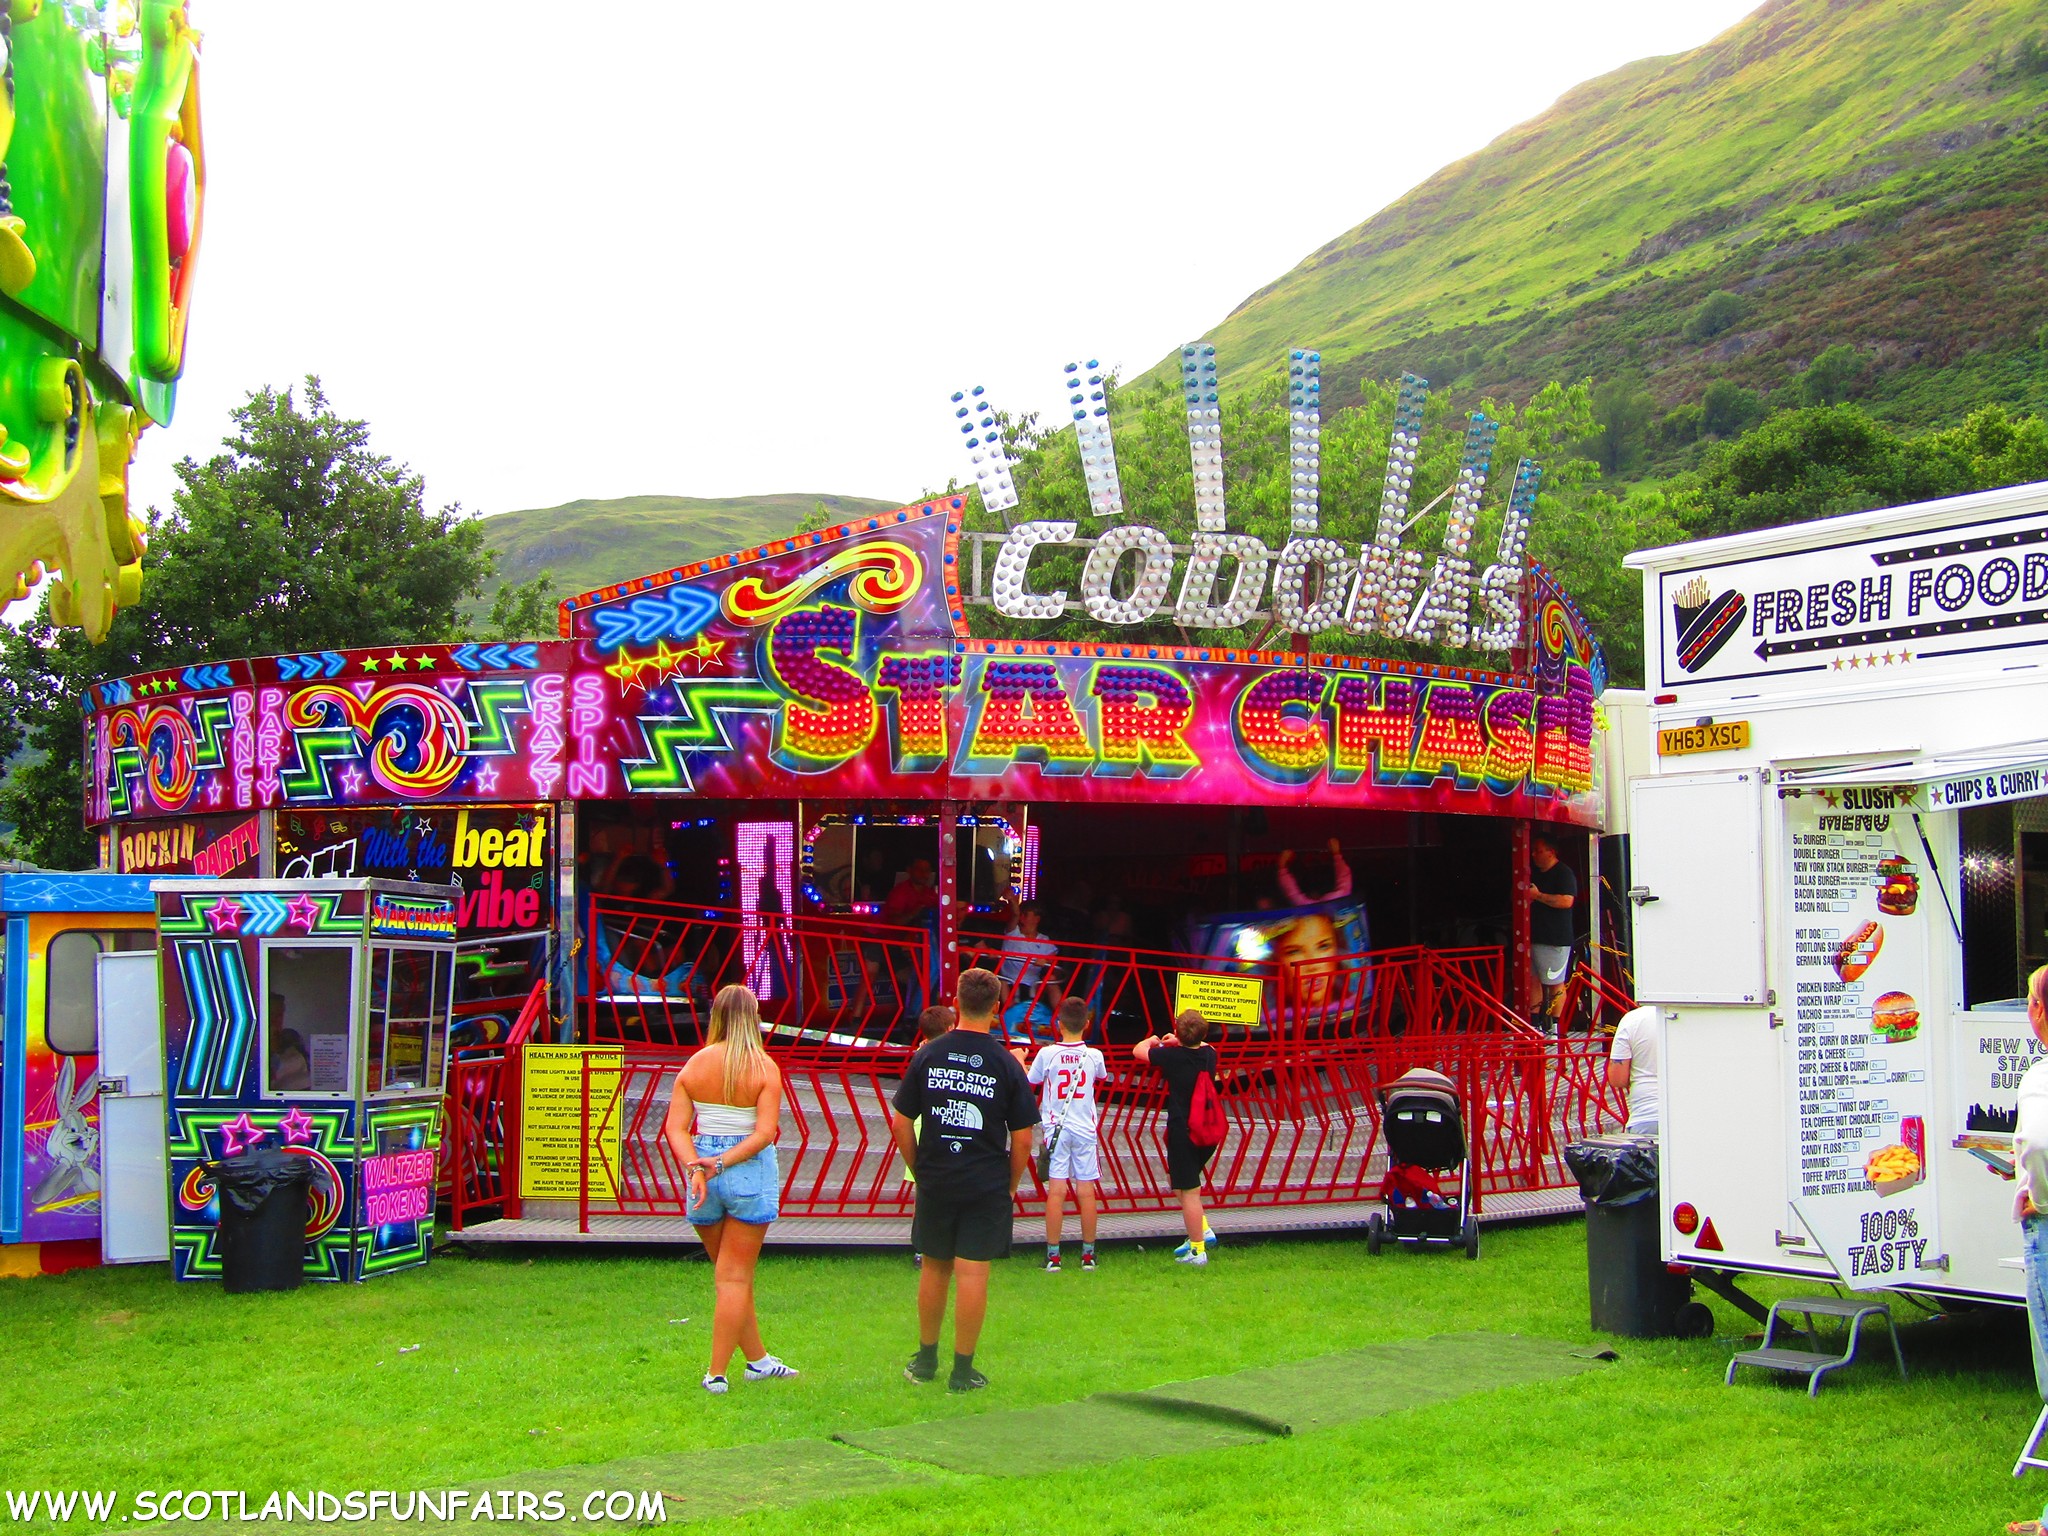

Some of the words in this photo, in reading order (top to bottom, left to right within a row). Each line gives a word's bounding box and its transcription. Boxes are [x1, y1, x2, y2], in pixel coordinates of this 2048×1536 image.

[992, 519, 1524, 652] CODONAS
[1753, 574, 1892, 637] FRESH
[1908, 552, 2048, 617] FOOD
[760, 604, 1201, 770] STAR
[530, 675, 565, 795] CRAZY
[569, 676, 606, 796] SPIN
[1663, 730, 1704, 752] YH63
[1709, 724, 1741, 747] XSC
[233, 691, 254, 807] DANCE
[257, 690, 283, 805] PARTY
[1945, 778, 1982, 805] CHIPS
[1987, 777, 1997, 798] &
[2000, 770, 2040, 797] CURRY
[1843, 788, 1895, 810] SLUSH
[362, 826, 410, 868] With
[416, 828, 447, 868] the
[452, 810, 546, 868] beat
[1804, 835, 1827, 845] BURGER
[121, 823, 195, 873] ROCKIN
[193, 816, 259, 878] PARTY
[1794, 849, 1816, 859] DOUBLE
[1817, 849, 1840, 859] BURGER
[1794, 862, 1807, 872] NEW
[1809, 862, 1824, 872] YORK
[1826, 862, 1845, 873] STACK
[1847, 863, 1869, 873] BURGER
[1794, 876, 1816, 886] DALLAS
[1818, 876, 1840, 886] BURGER
[456, 870, 540, 928] vibe
[1795, 889, 1815, 899] BACON
[1816, 889, 1838, 899] BURGER
[1795, 902, 1815, 912] BACON
[1816, 902, 1830, 912] ROLL
[373, 895, 456, 938] STARCHASER
[1796, 929, 1807, 939] HOT
[1809, 928, 1821, 939] DOG
[1796, 942, 1826, 953] FOOTLONG
[1827, 942, 1854, 952] SAUSAGE
[1796, 956, 1821, 966] GERMAN
[1797, 982, 1821, 993] CHICKEN
[1824, 982, 1846, 992] BURGER
[1797, 996, 1822, 1006] CHICKEN
[1824, 995, 1841, 1005] WRAP
[1797, 1009, 1822, 1019] NACHOS
[1798, 1023, 1815, 1033] CHIPS
[1798, 1036, 1818, 1048] CHIPS,
[1820, 1035, 1839, 1046] CURRY
[1841, 1035, 1849, 1045] OR
[1850, 1034, 1869, 1045] GRAVY
[1980, 1038, 2020, 1054] NEW
[1799, 1049, 1816, 1060] CHIPS
[1818, 1049, 1823, 1060] &
[1825, 1048, 1846, 1059] CHEESE
[1799, 1063, 1819, 1075] CHIPS,
[1820, 1062, 1842, 1073] CHEESE
[1843, 1061, 1848, 1071] &
[1850, 1061, 1869, 1071] CURRY
[1998, 1055, 2043, 1072] STA
[928, 1067, 965, 1080] NEVER
[967, 1072, 997, 1086] STOP
[1799, 1076, 1811, 1087] SALT
[1812, 1076, 1817, 1087] &
[1818, 1075, 1833, 1086] CHILLI
[1834, 1074, 1849, 1085] CHIPS
[1891, 1072, 1908, 1082] CURRY
[928, 1078, 994, 1099] EXPLORING
[1058, 1069, 1086, 1099] 22
[1800, 1090, 1818, 1101] CAJUN
[1820, 1089, 1835, 1100] CHIPS
[947, 1099, 967, 1110] THE
[1800, 1103, 1819, 1115] SLUSH
[1839, 1101, 1857, 1112] TWIST
[1859, 1101, 1871, 1111] CUP
[931, 1106, 966, 1118] NORTH
[941, 1116, 966, 1127] FACE
[1849, 1113, 1881, 1126] CHOCOLATE
[1801, 1130, 1818, 1142] CANS
[1837, 1127, 1862, 1139] BOTTLES
[1802, 1144, 1821, 1156] CANDY
[1823, 1143, 1842, 1154] FLOSS
[364, 1149, 435, 1190] WALTZER
[1802, 1157, 1830, 1169] DUMMIES
[1802, 1171, 1823, 1183] TOFFEE
[1825, 1170, 1847, 1181] APPLES
[1802, 1185, 1820, 1197] MORE
[1822, 1183, 1845, 1195] SWEETS
[1847, 1180, 1877, 1193] AVAILABLE
[366, 1186, 429, 1227] TOKENS
[1860, 1208, 1918, 1242] 100%
[1848, 1238, 1927, 1277] TASTY
